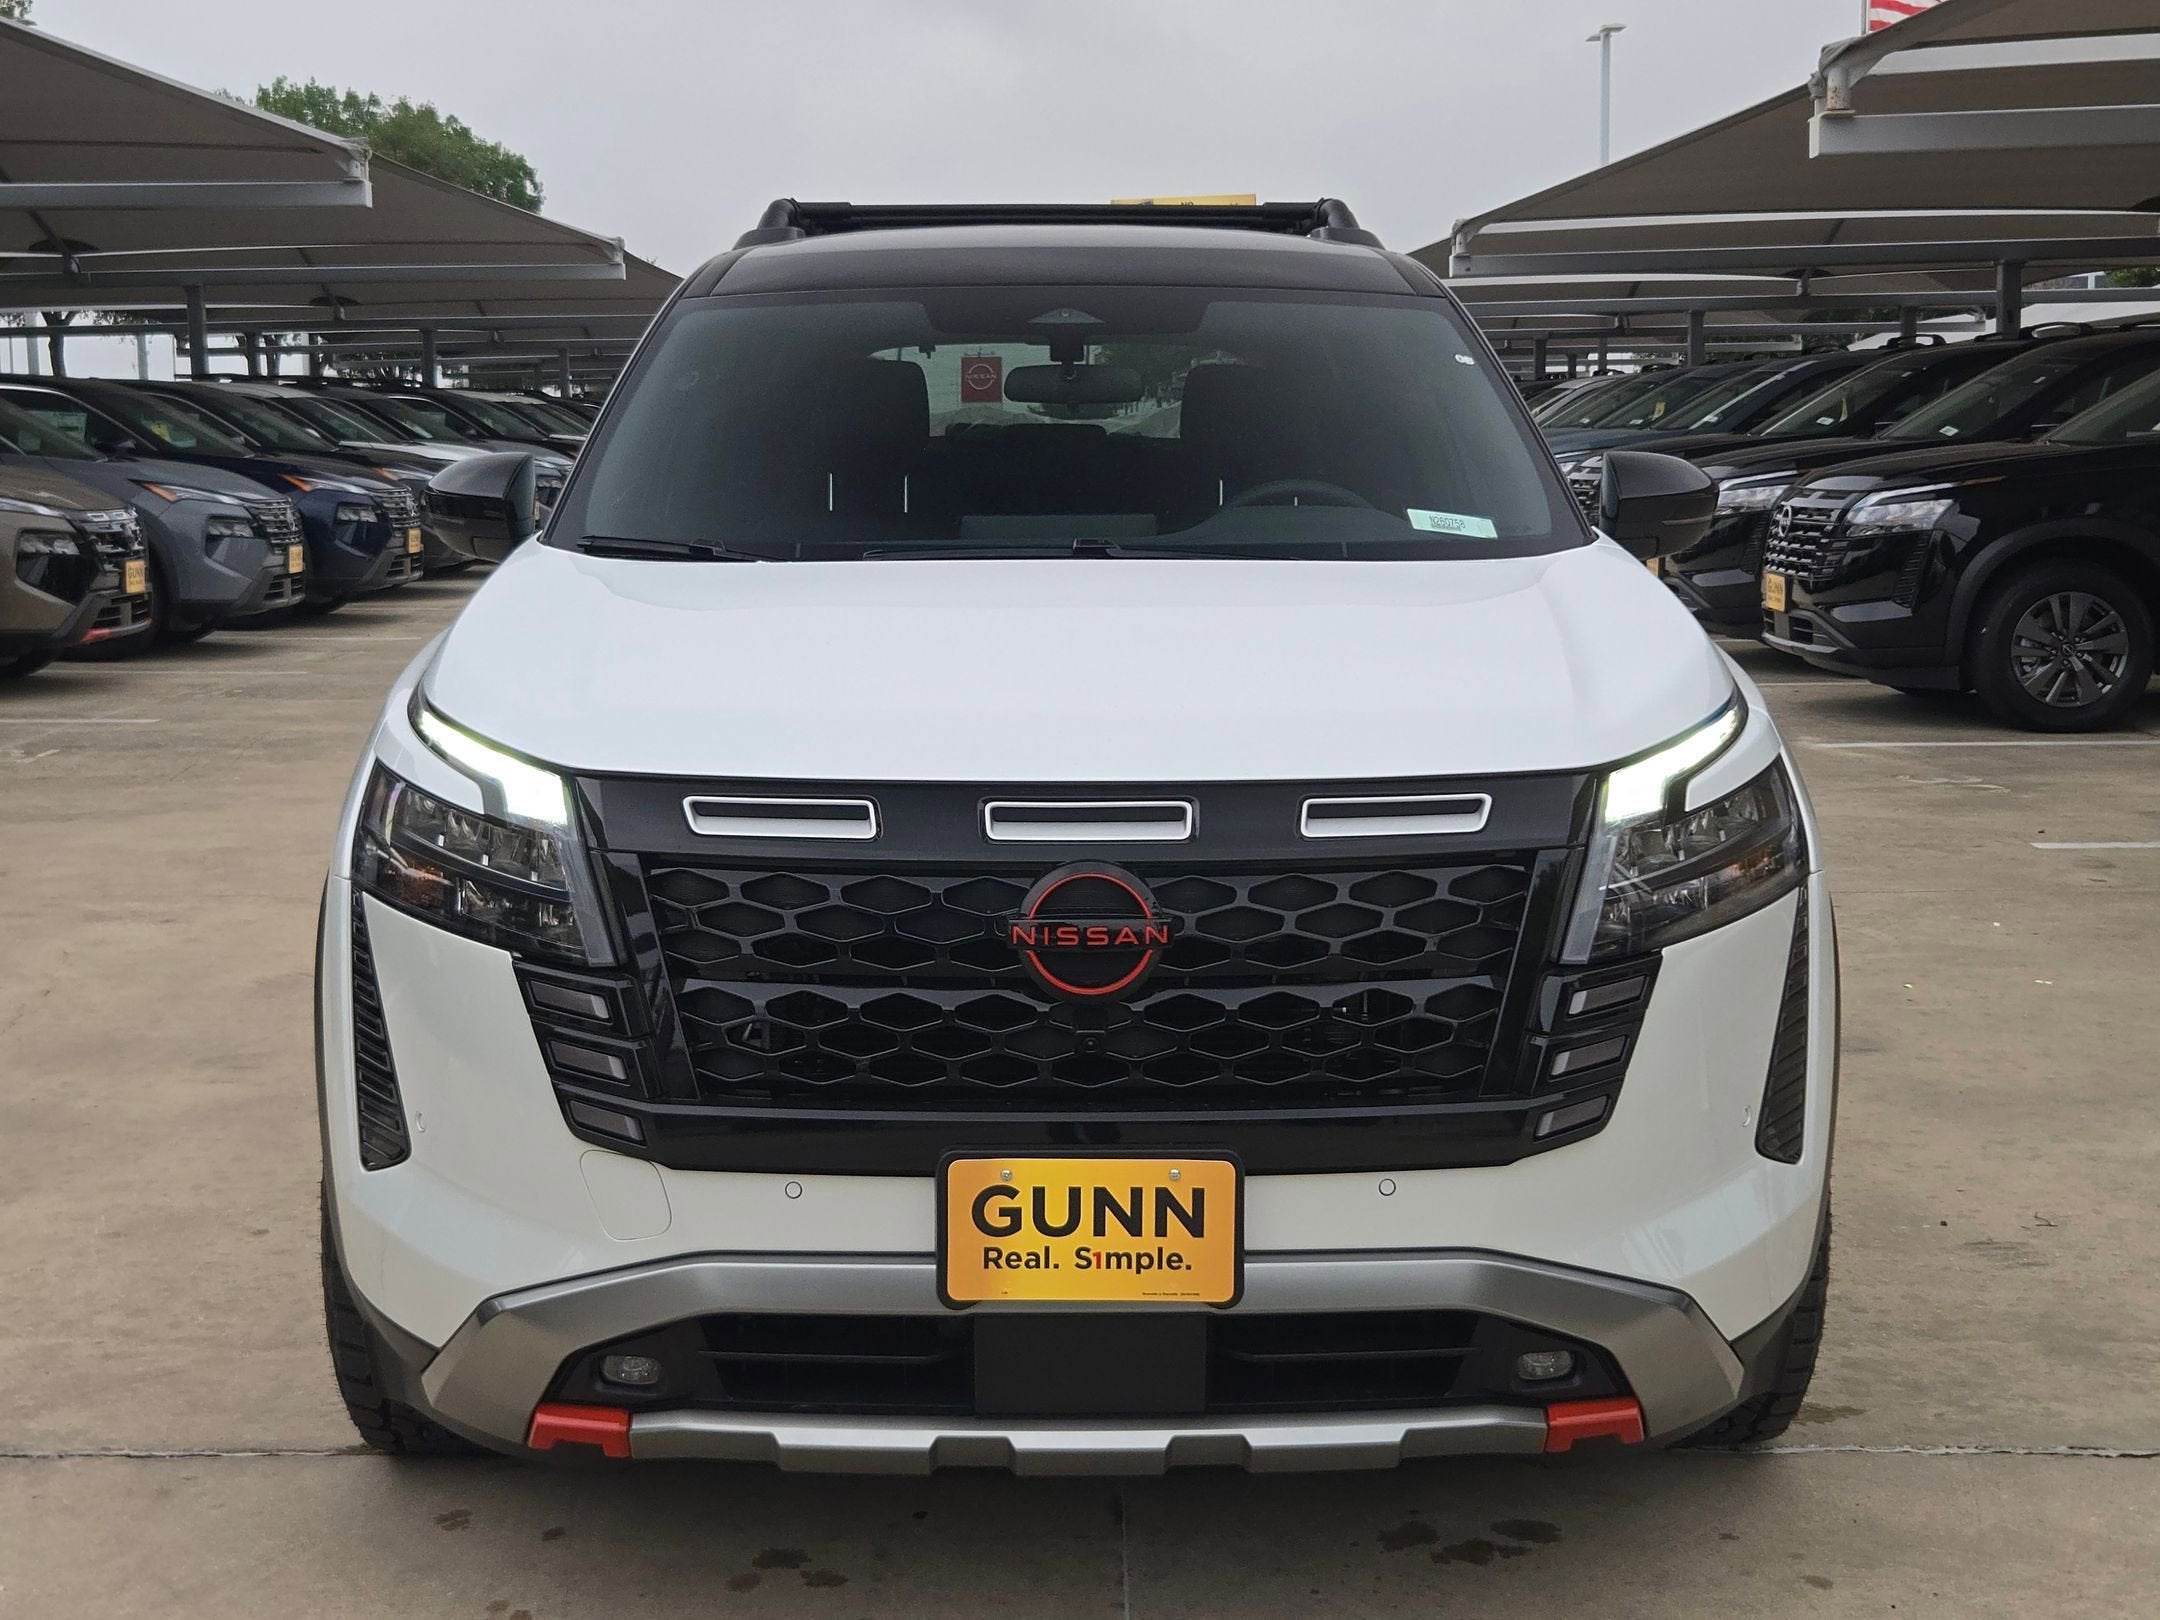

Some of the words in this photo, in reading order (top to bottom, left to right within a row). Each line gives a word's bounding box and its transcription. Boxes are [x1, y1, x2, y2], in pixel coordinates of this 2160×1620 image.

[1011, 924, 1169, 946] NISSAN
[971, 1184, 1205, 1238] GUNN
[983, 1246, 1060, 1270] Real.
